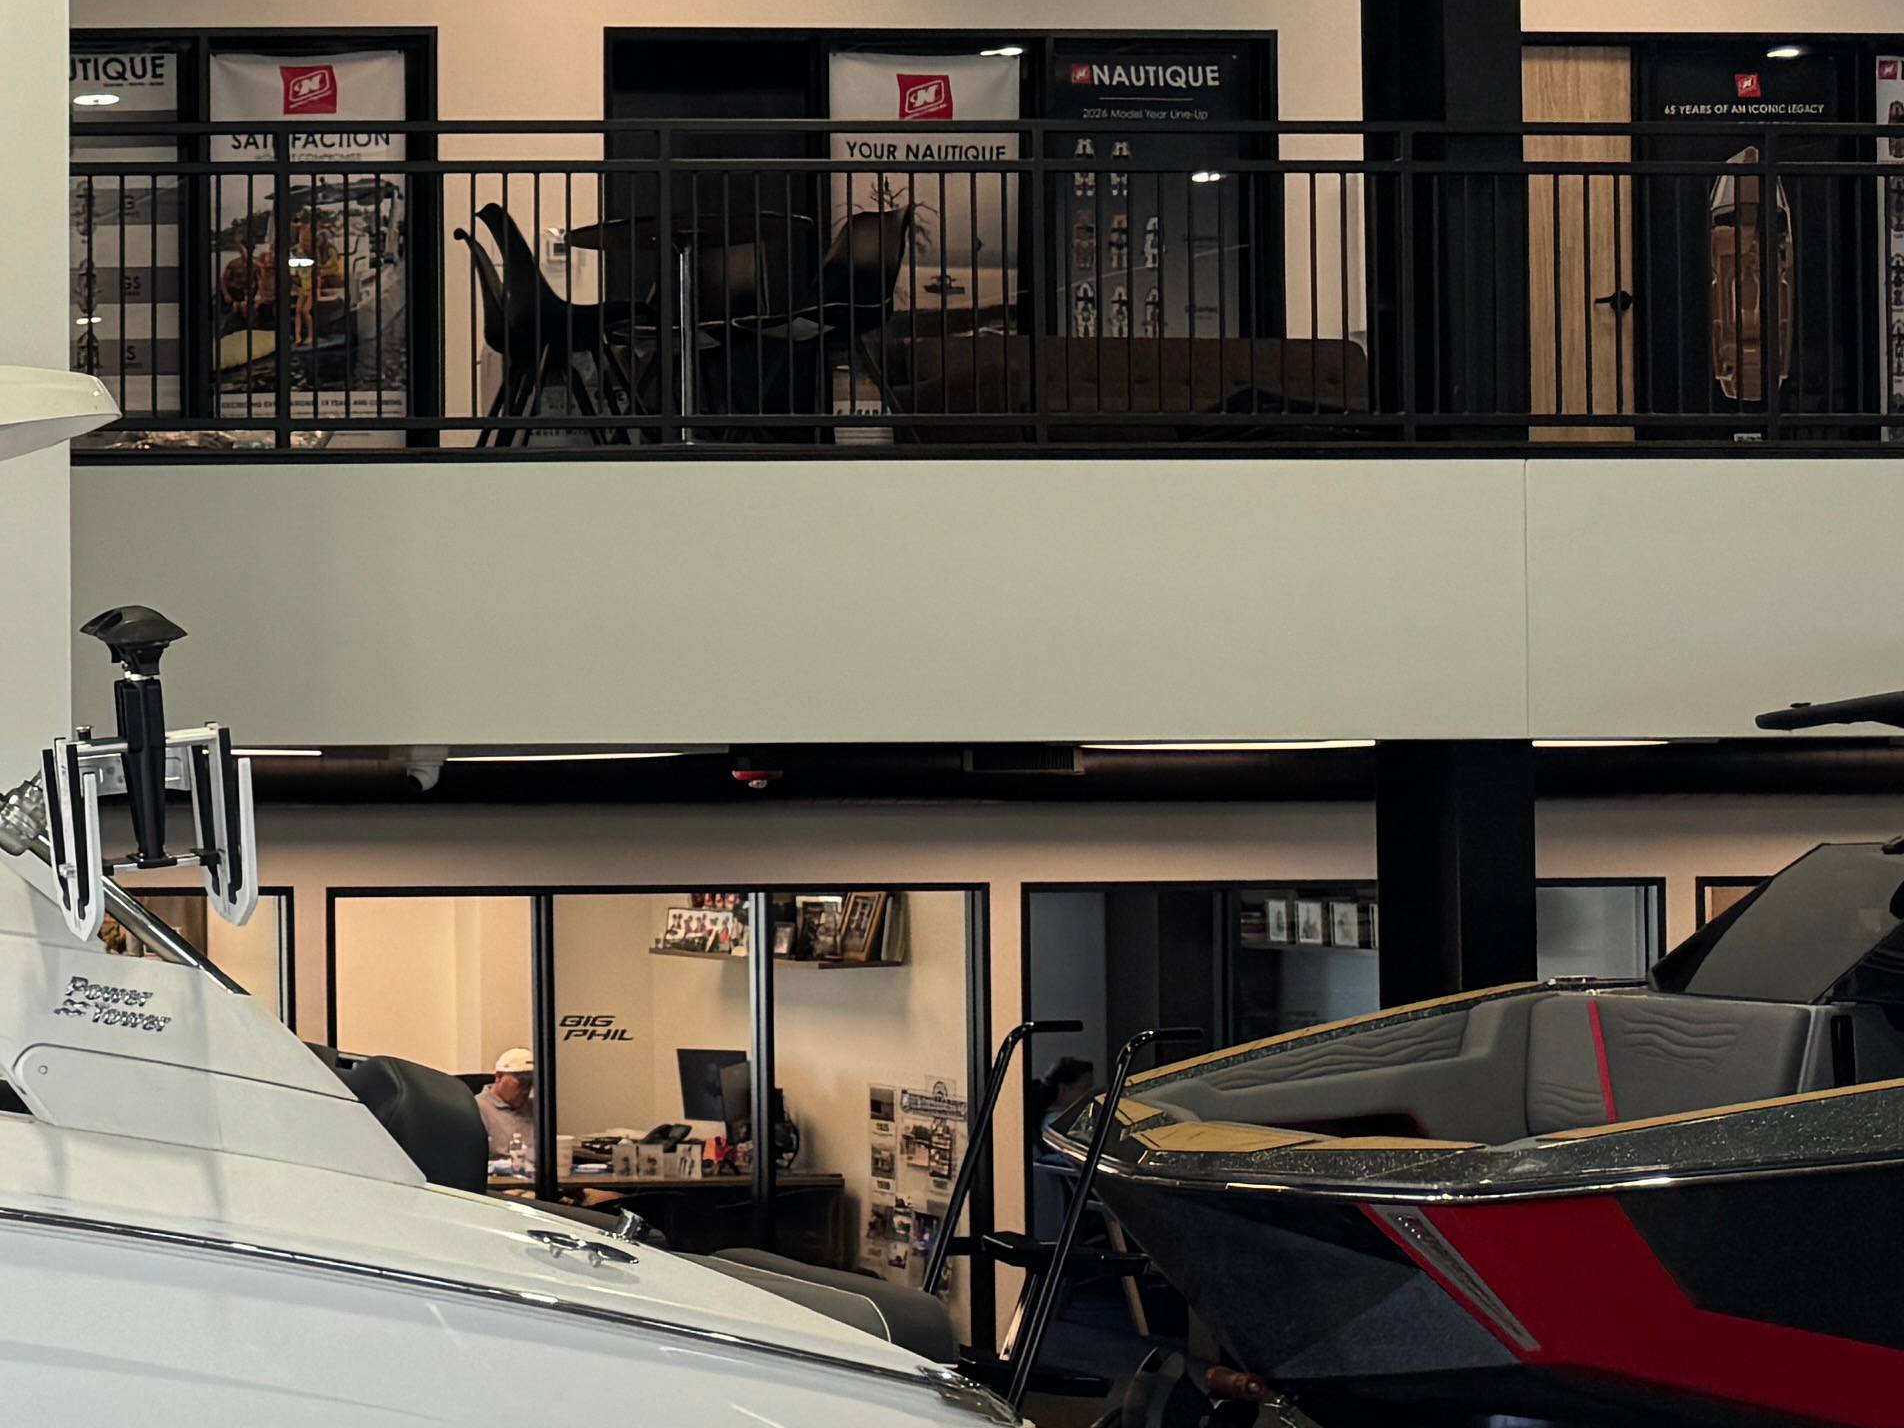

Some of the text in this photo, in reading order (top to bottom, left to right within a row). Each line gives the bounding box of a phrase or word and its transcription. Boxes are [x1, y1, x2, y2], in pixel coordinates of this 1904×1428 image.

[1092, 65, 1220, 88] NAUTIQUE
[1110, 108, 1143, 120] Model
[1145, 109, 1167, 120] Year
[1679, 105, 1712, 115] YEARS
[1714, 104, 1729, 114] OF
[1748, 104, 1786, 114] ICONIC
[1788, 104, 1825, 114] LEGACY
[231, 132, 390, 150] SATIFACTION
[846, 141, 1006, 162] YOUR NAUTIQUE
[64, 975, 154, 1007] Power
[91, 1002, 173, 1032] Tower
[559, 1015, 617, 1028] BIG
[563, 1029, 634, 1042] PHIL
